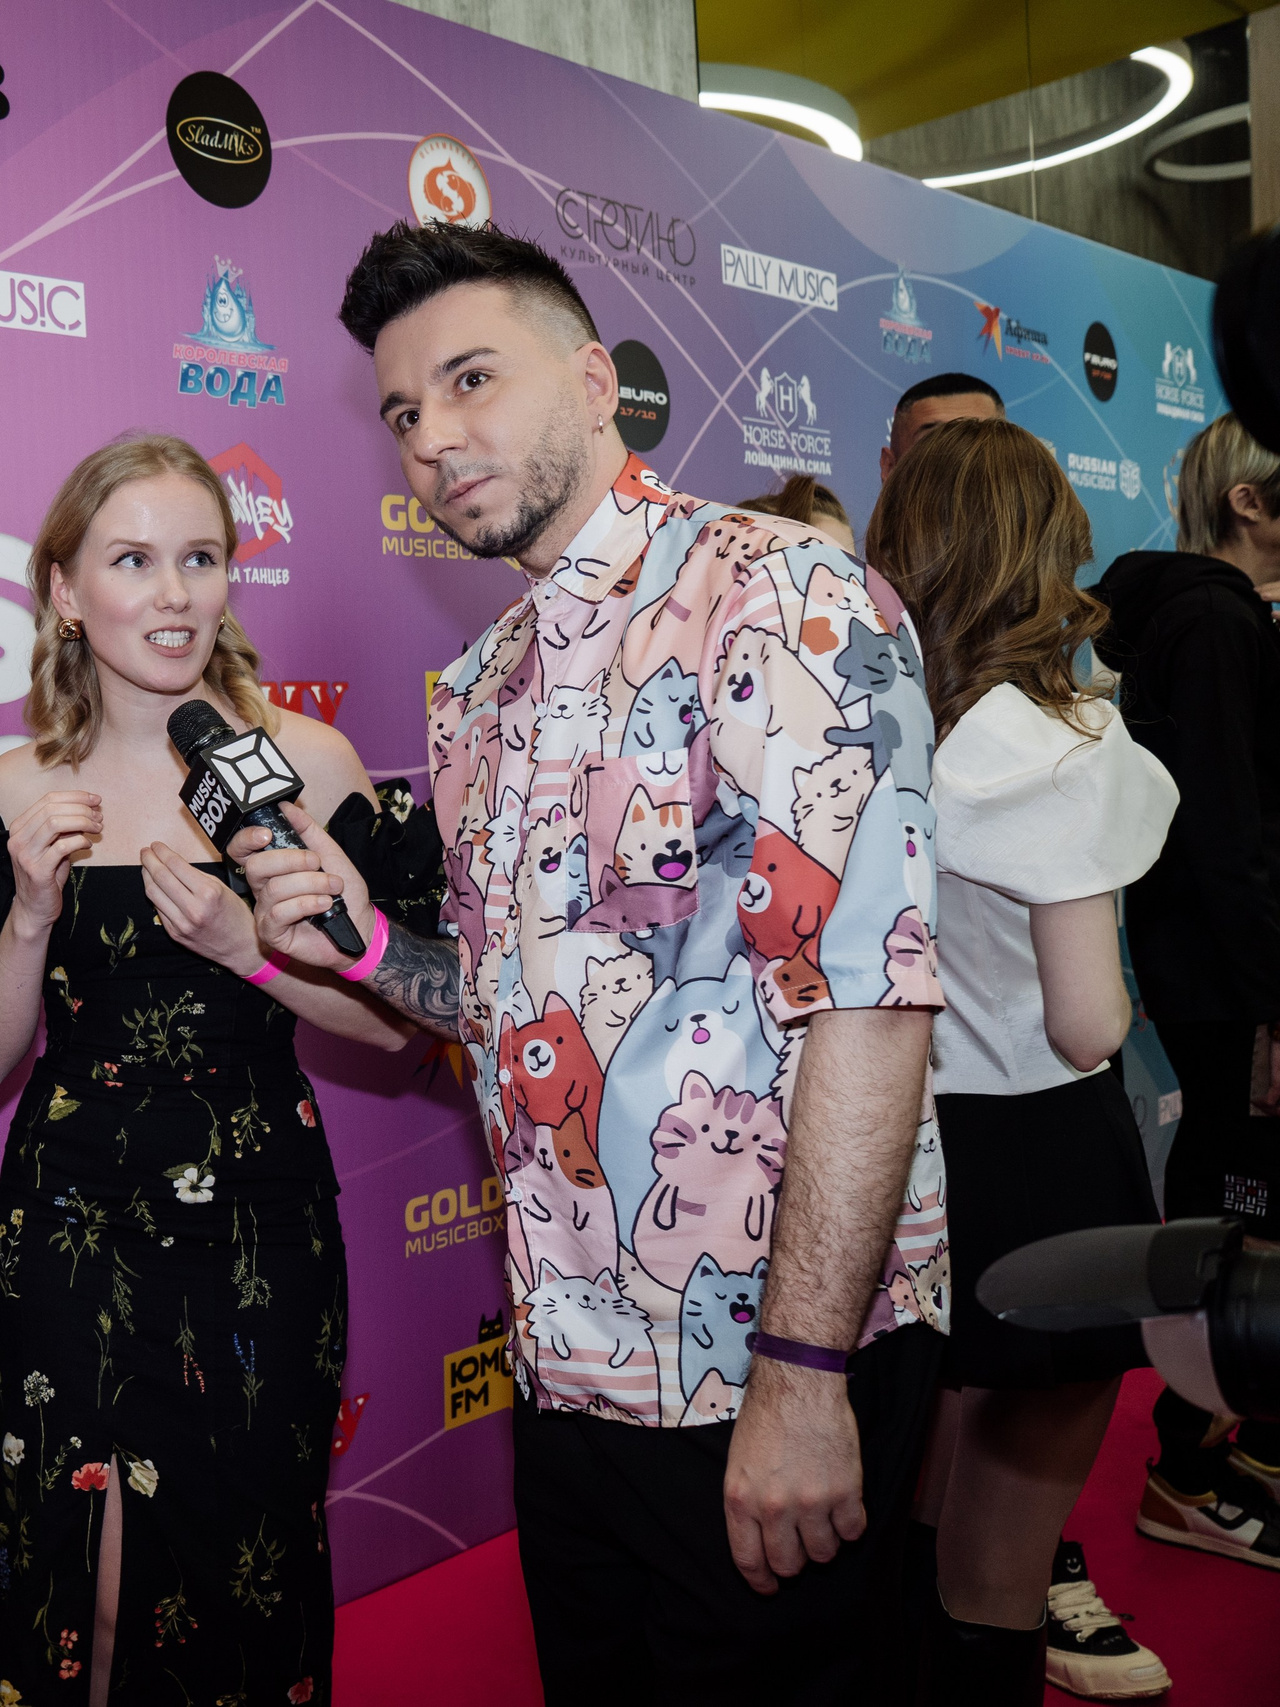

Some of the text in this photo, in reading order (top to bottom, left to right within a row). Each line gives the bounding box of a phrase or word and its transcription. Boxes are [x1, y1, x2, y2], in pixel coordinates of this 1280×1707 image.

[555, 188, 697, 267] СТРОГИНО
[560, 245, 697, 287] КУЛЬТУРНЫЙ ЦЕНТР
[723, 249, 835, 306] PALLY MUSIC
[173, 344, 289, 373] КОРОЛЕВСКАЯ
[178, 361, 286, 409] ВОДА
[619, 385, 668, 406] BURO
[779, 384, 794, 413] H
[743, 425, 832, 456] HORSE FORCE
[744, 450, 832, 475] ЛОШАДИНАЯ СИЛА
[1068, 453, 1117, 476] RUSSIAN
[381, 494, 446, 535] GO
[382, 535, 480, 561] MUSICBO
[243, 567, 290, 587] ТАНЦЕВ
[188, 770, 216, 818] MUSIC
[199, 784, 232, 838] BOX
[405, 1176, 503, 1233] GOLD
[405, 1213, 505, 1259] MUSICBOX
[451, 1380, 489, 1419] FM
